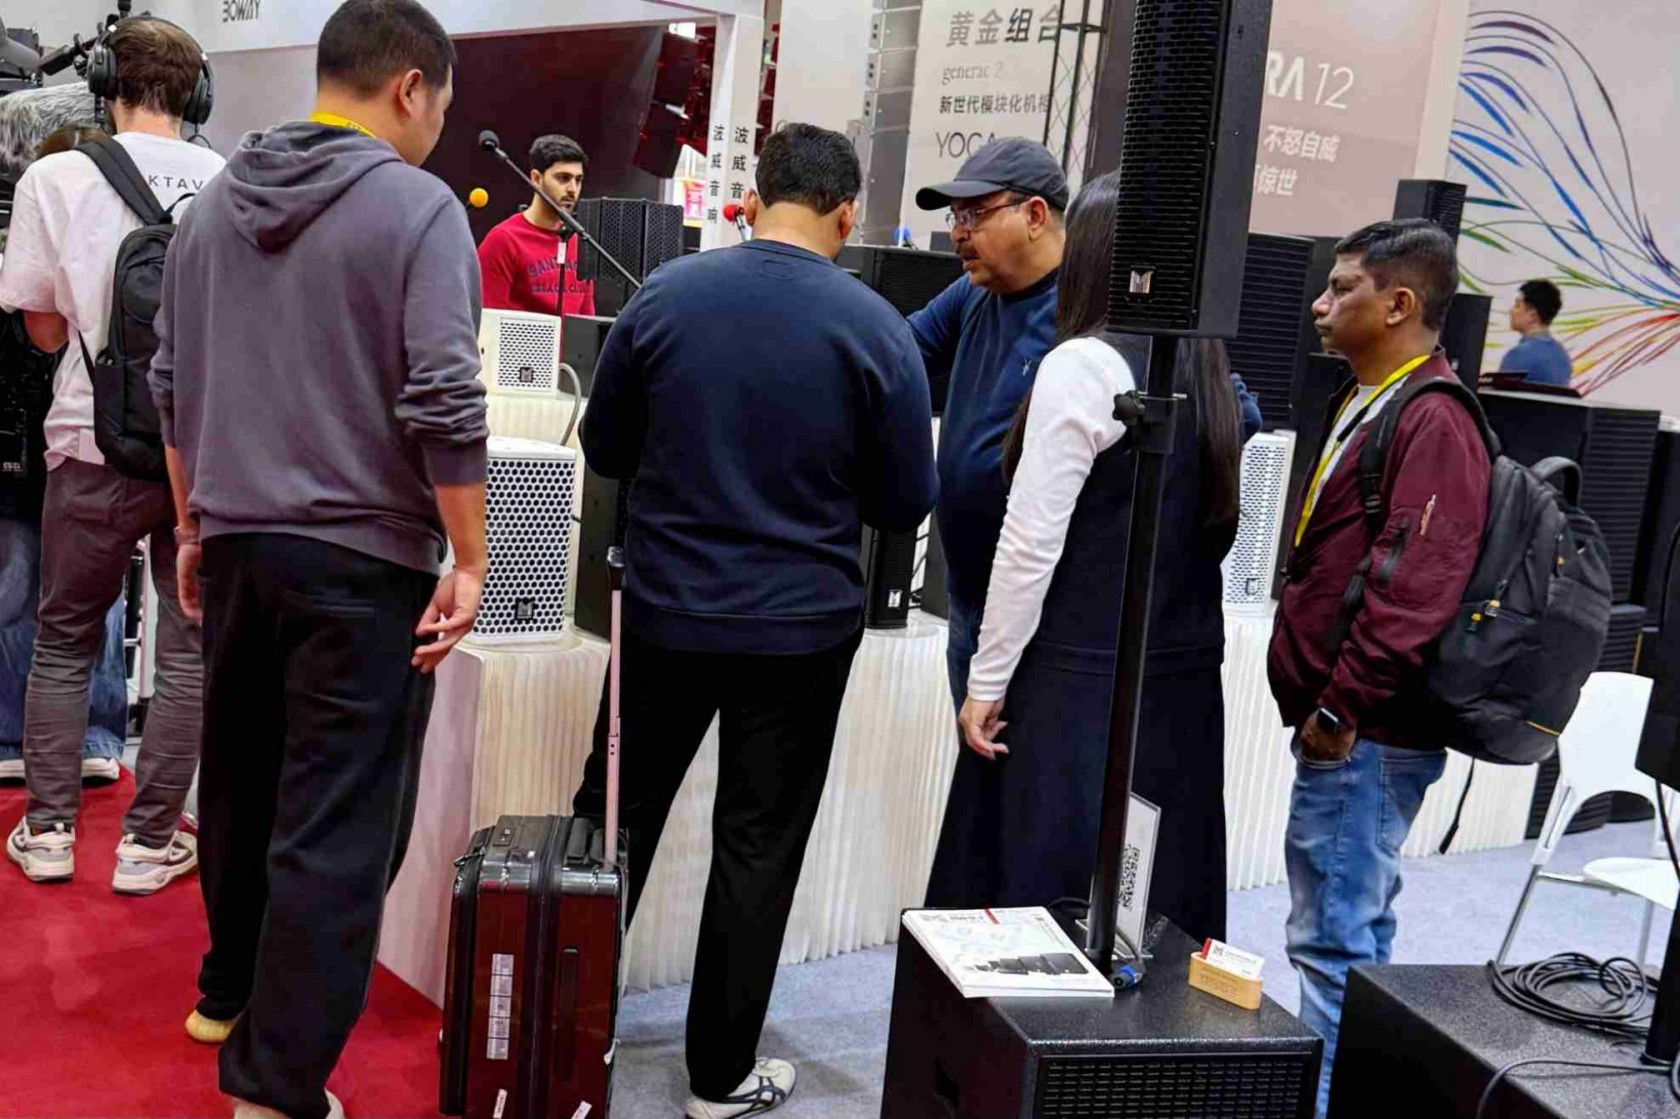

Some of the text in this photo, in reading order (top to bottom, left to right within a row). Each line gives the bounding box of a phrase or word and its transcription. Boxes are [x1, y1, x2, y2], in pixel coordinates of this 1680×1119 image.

[1315, 62, 1354, 110] 12
[730, 126, 749, 199] 波威音
[1254, 164, 1298, 196] 惊世
